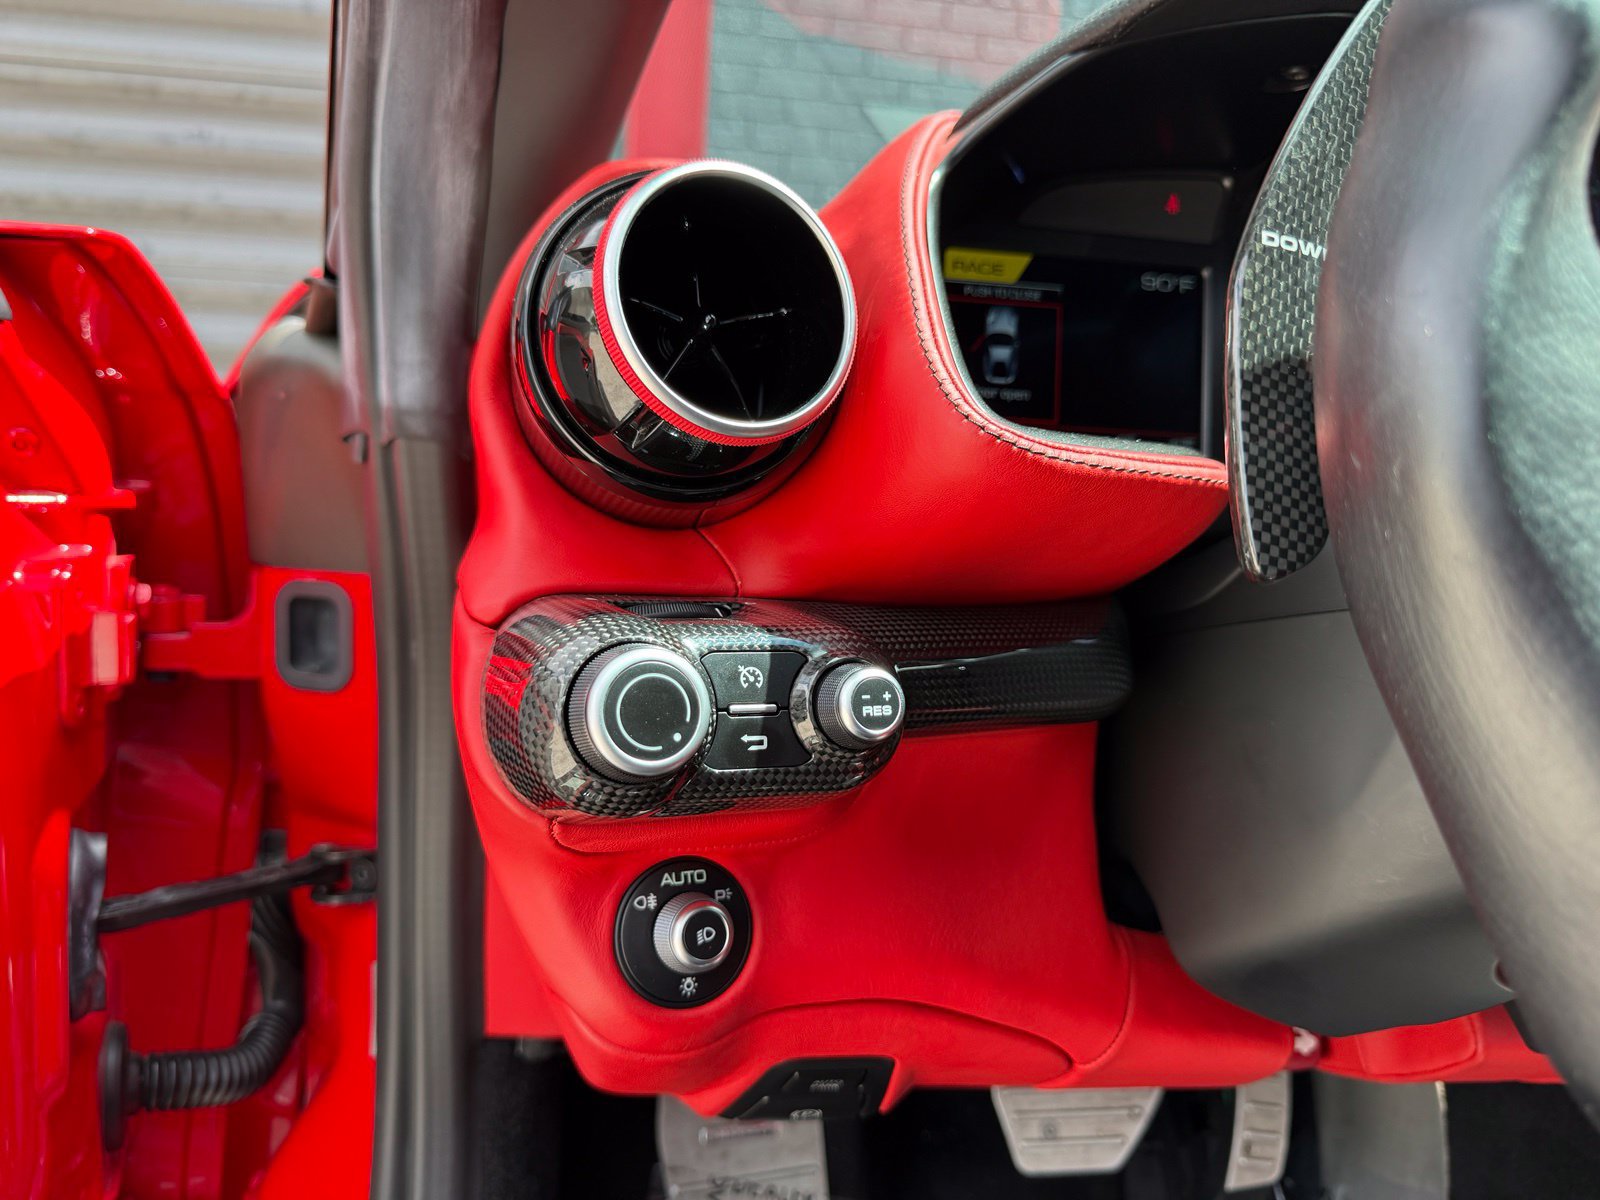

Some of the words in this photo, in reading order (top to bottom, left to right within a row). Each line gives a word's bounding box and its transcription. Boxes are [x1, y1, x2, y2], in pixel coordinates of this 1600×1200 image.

[1261, 229, 1327, 262] DOW
[951, 259, 1004, 276] RACE
[999, 388, 1032, 403] open
[862, 704, 893, 717] RES
[660, 869, 707, 887] AUTO
